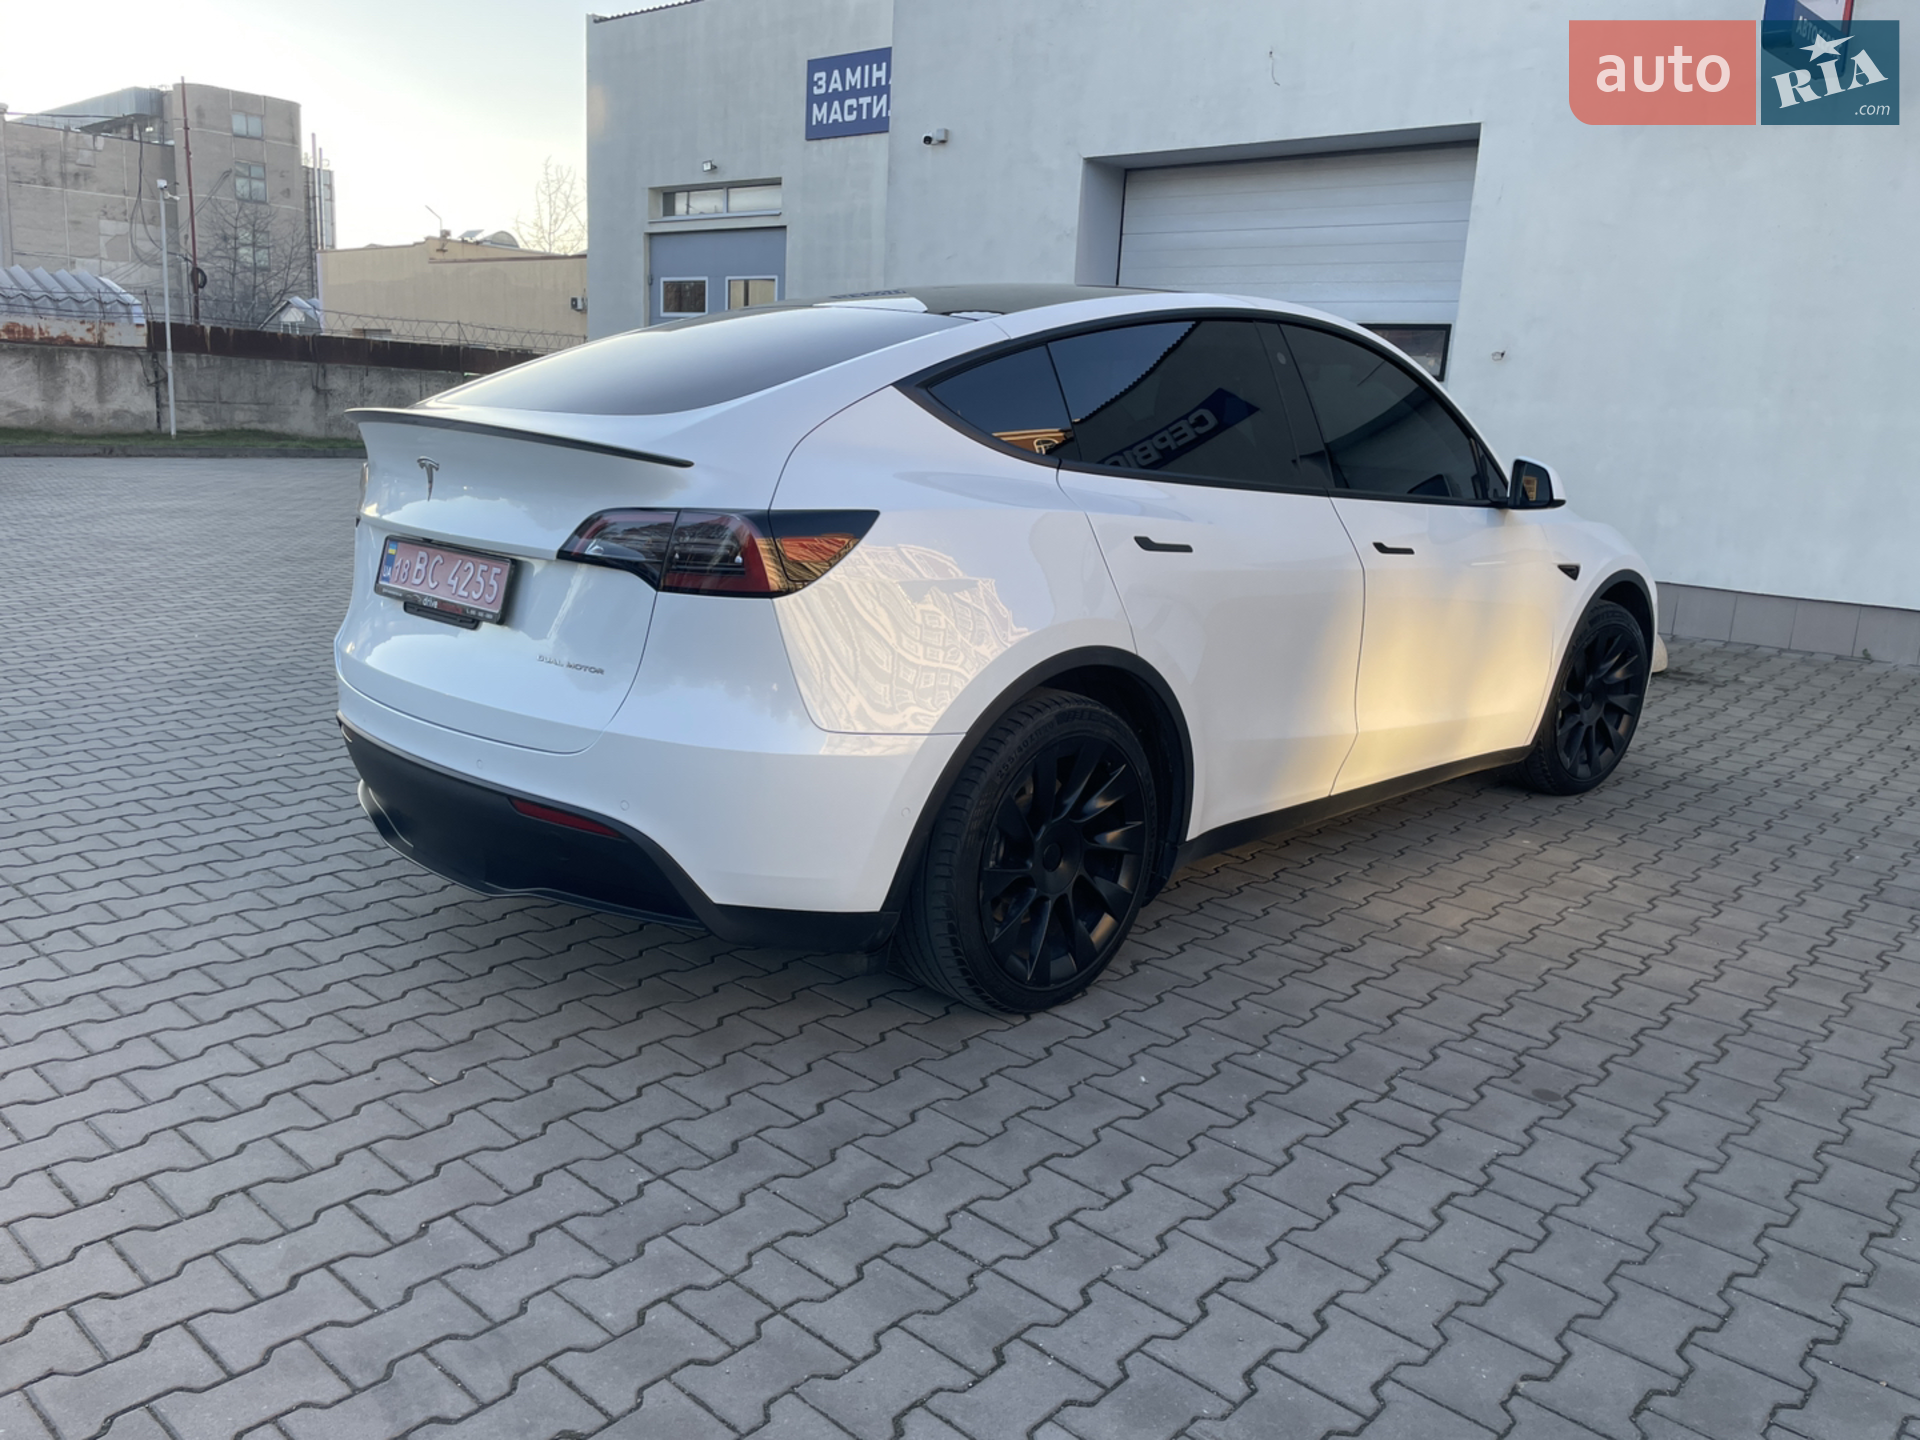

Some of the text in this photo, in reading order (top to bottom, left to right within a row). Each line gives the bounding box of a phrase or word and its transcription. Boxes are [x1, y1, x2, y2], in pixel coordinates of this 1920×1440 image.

[813, 62, 891, 95] ЗАМІН
[812, 94, 891, 126] МАСТИ
[394, 551, 502, 604] 18 BC 4255
[537, 655, 605, 675] DUAL MOTOR
